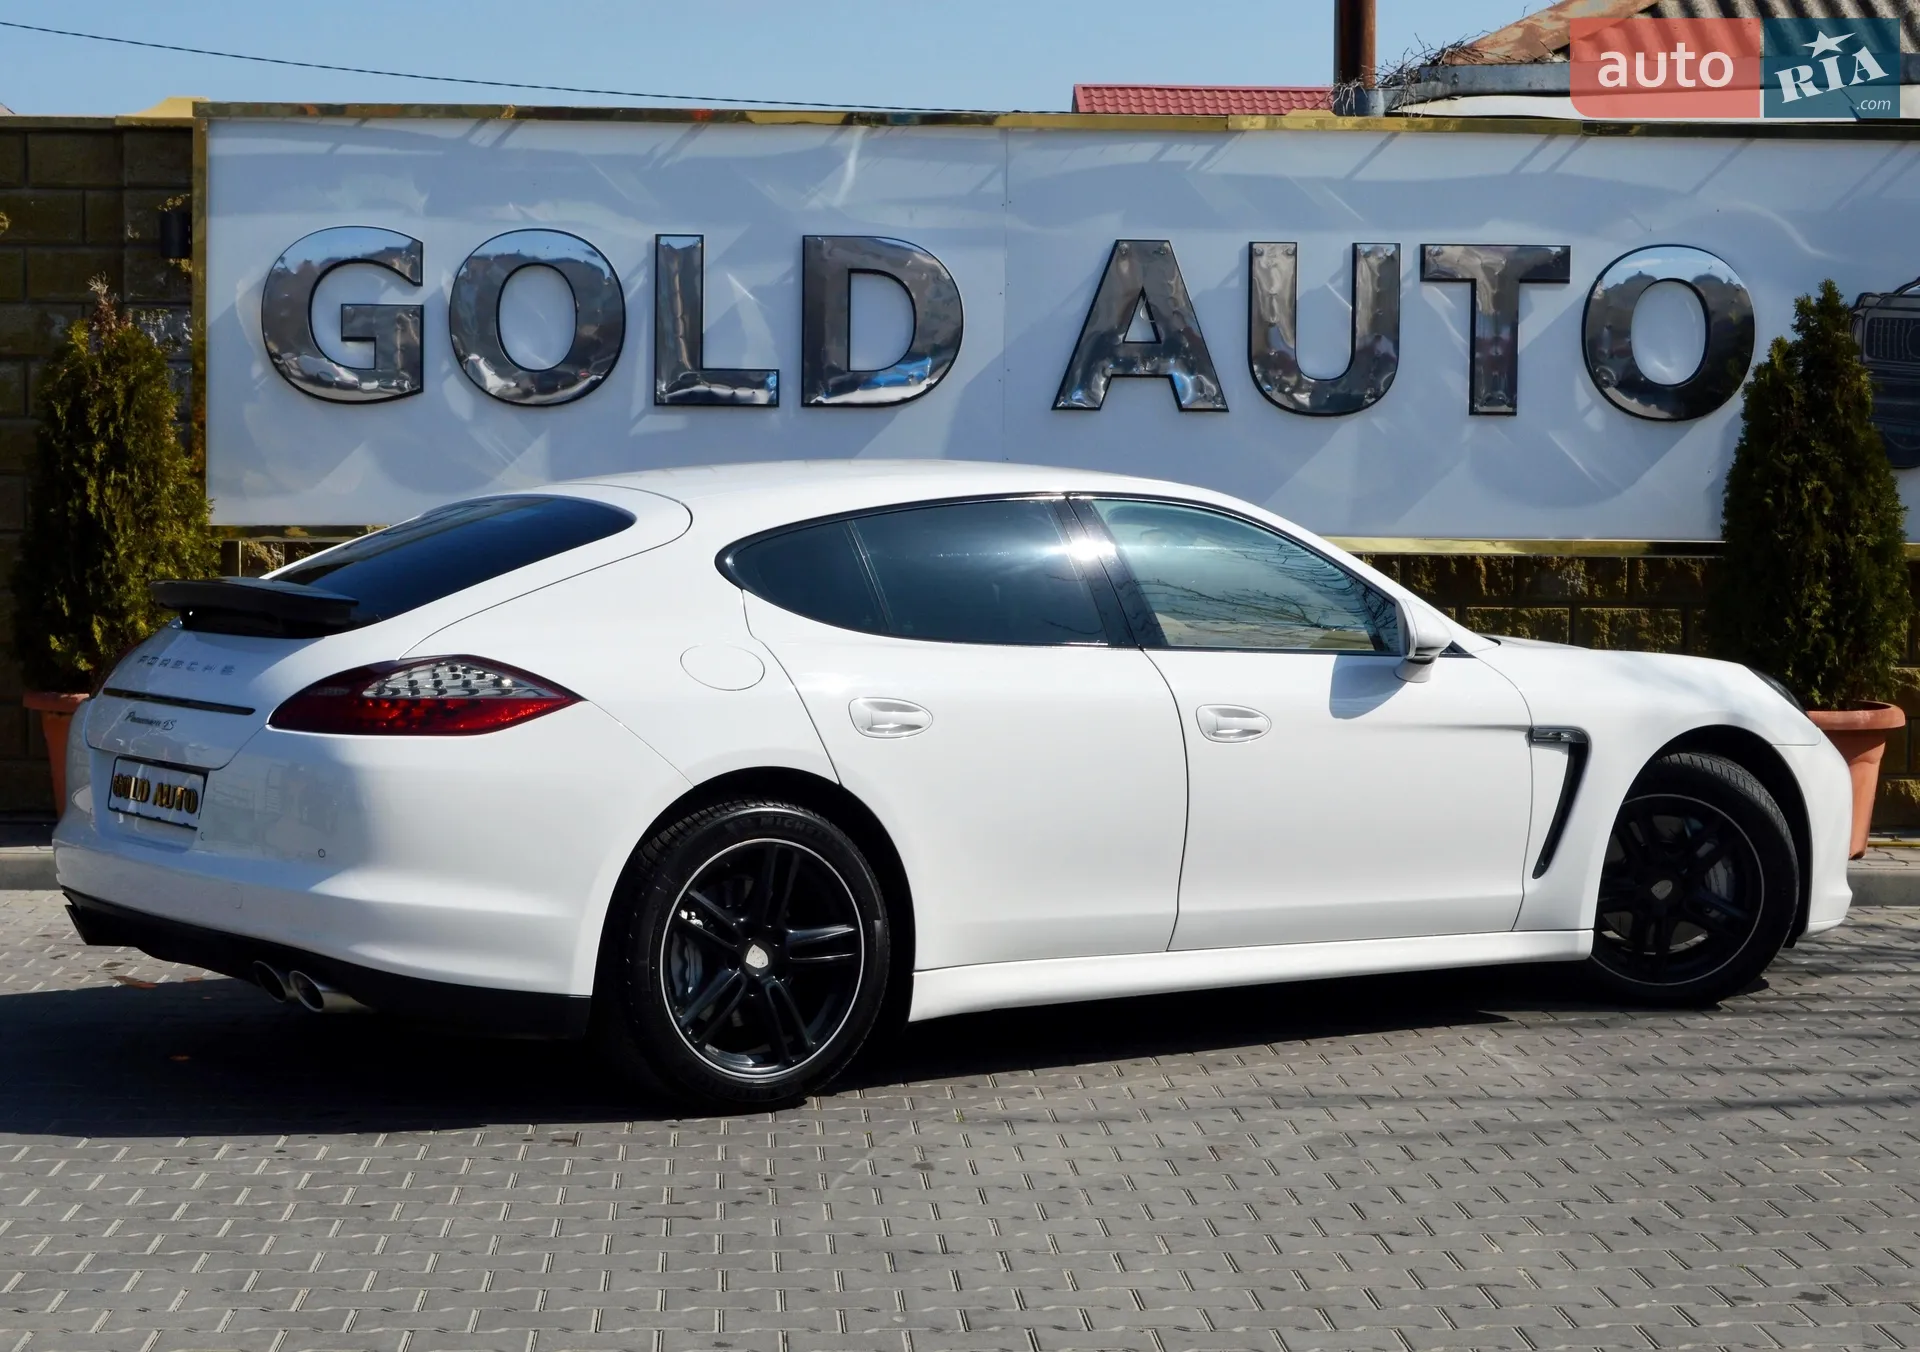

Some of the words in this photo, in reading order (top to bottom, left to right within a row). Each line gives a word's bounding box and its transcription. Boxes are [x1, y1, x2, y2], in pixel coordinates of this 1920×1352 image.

[261, 225, 964, 407] GOLD
[1051, 238, 1756, 421] AUTO
[137, 655, 236, 676] PORSCHE
[112, 772, 151, 803] GOLD
[152, 782, 199, 814] AUTO
